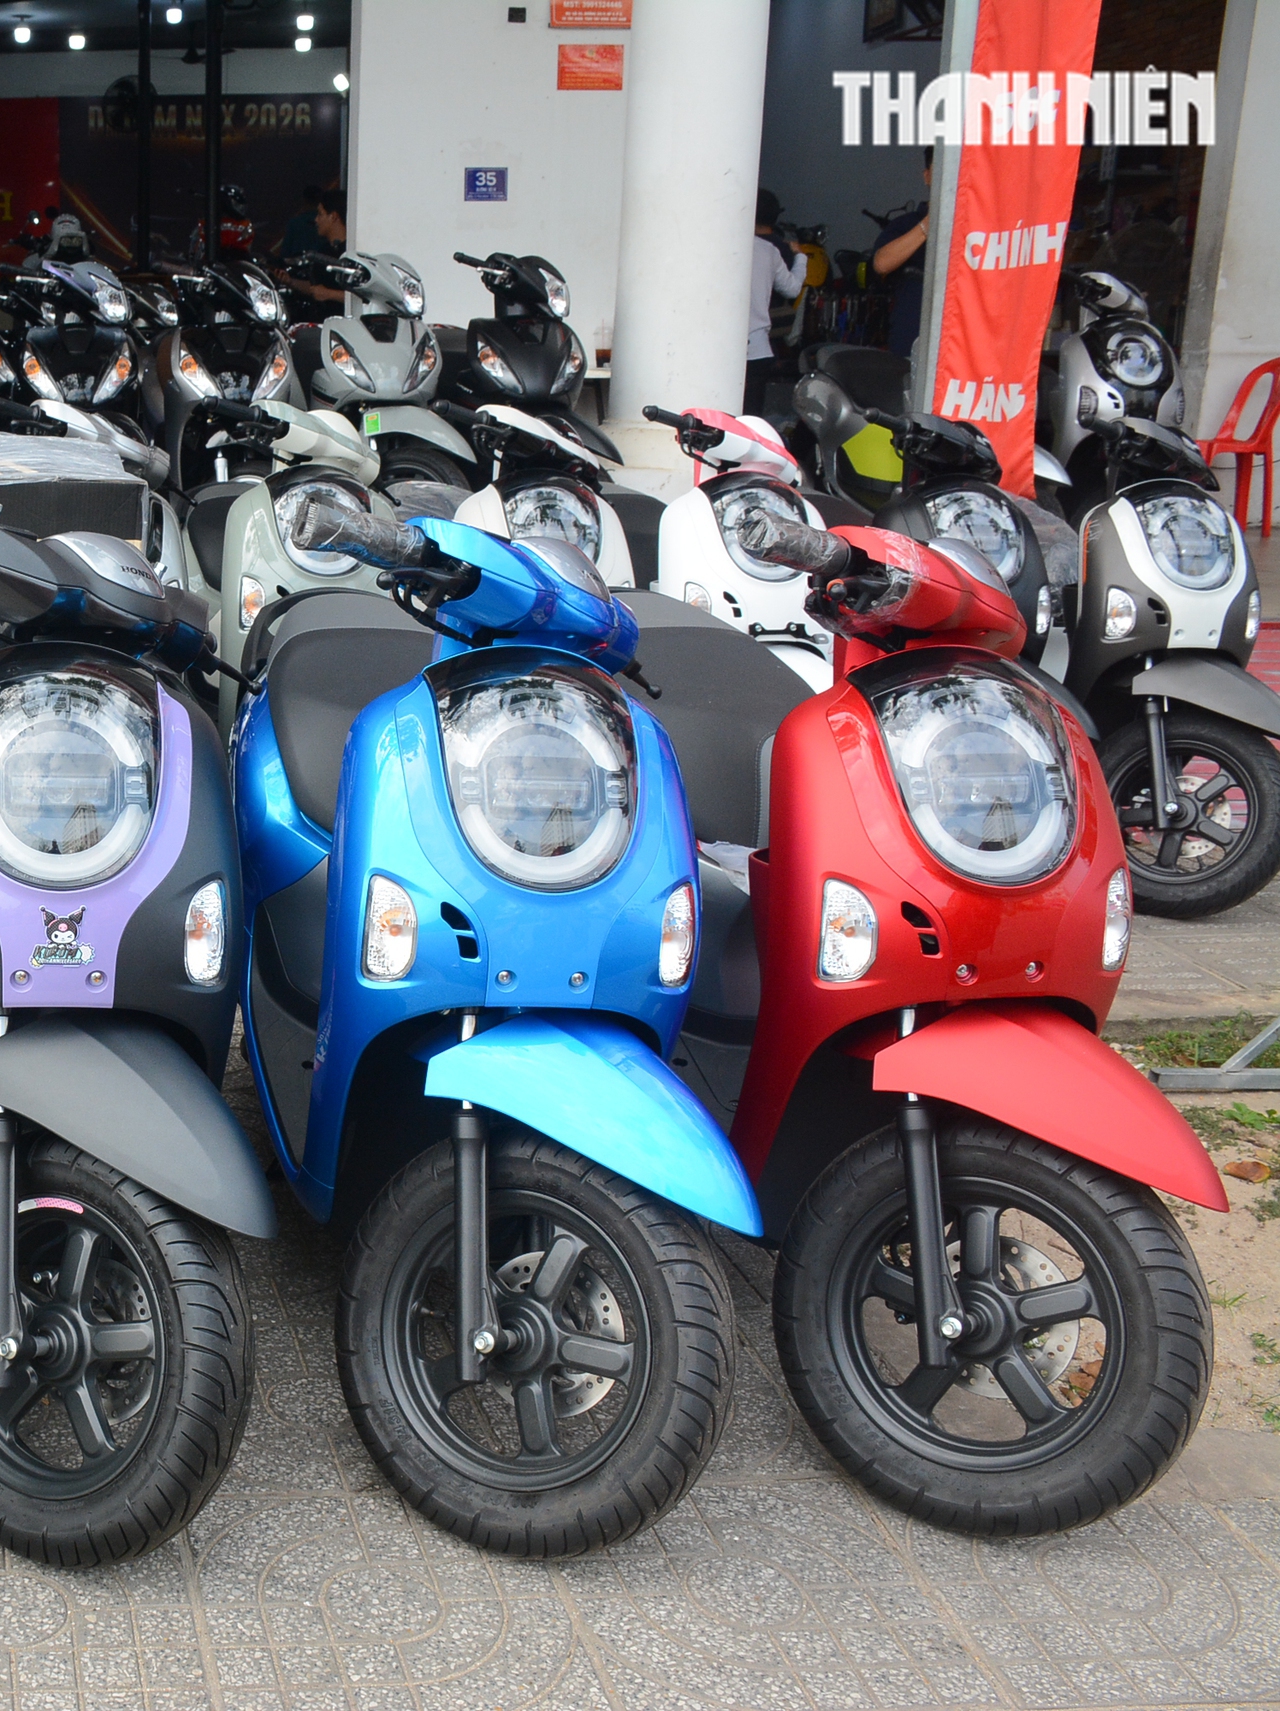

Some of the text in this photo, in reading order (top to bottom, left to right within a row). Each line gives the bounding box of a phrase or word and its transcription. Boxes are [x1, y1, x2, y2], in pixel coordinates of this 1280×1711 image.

[243, 102, 312, 132] 2026
[475, 171, 497, 187] 35
[964, 219, 1067, 271] CHÍNH
